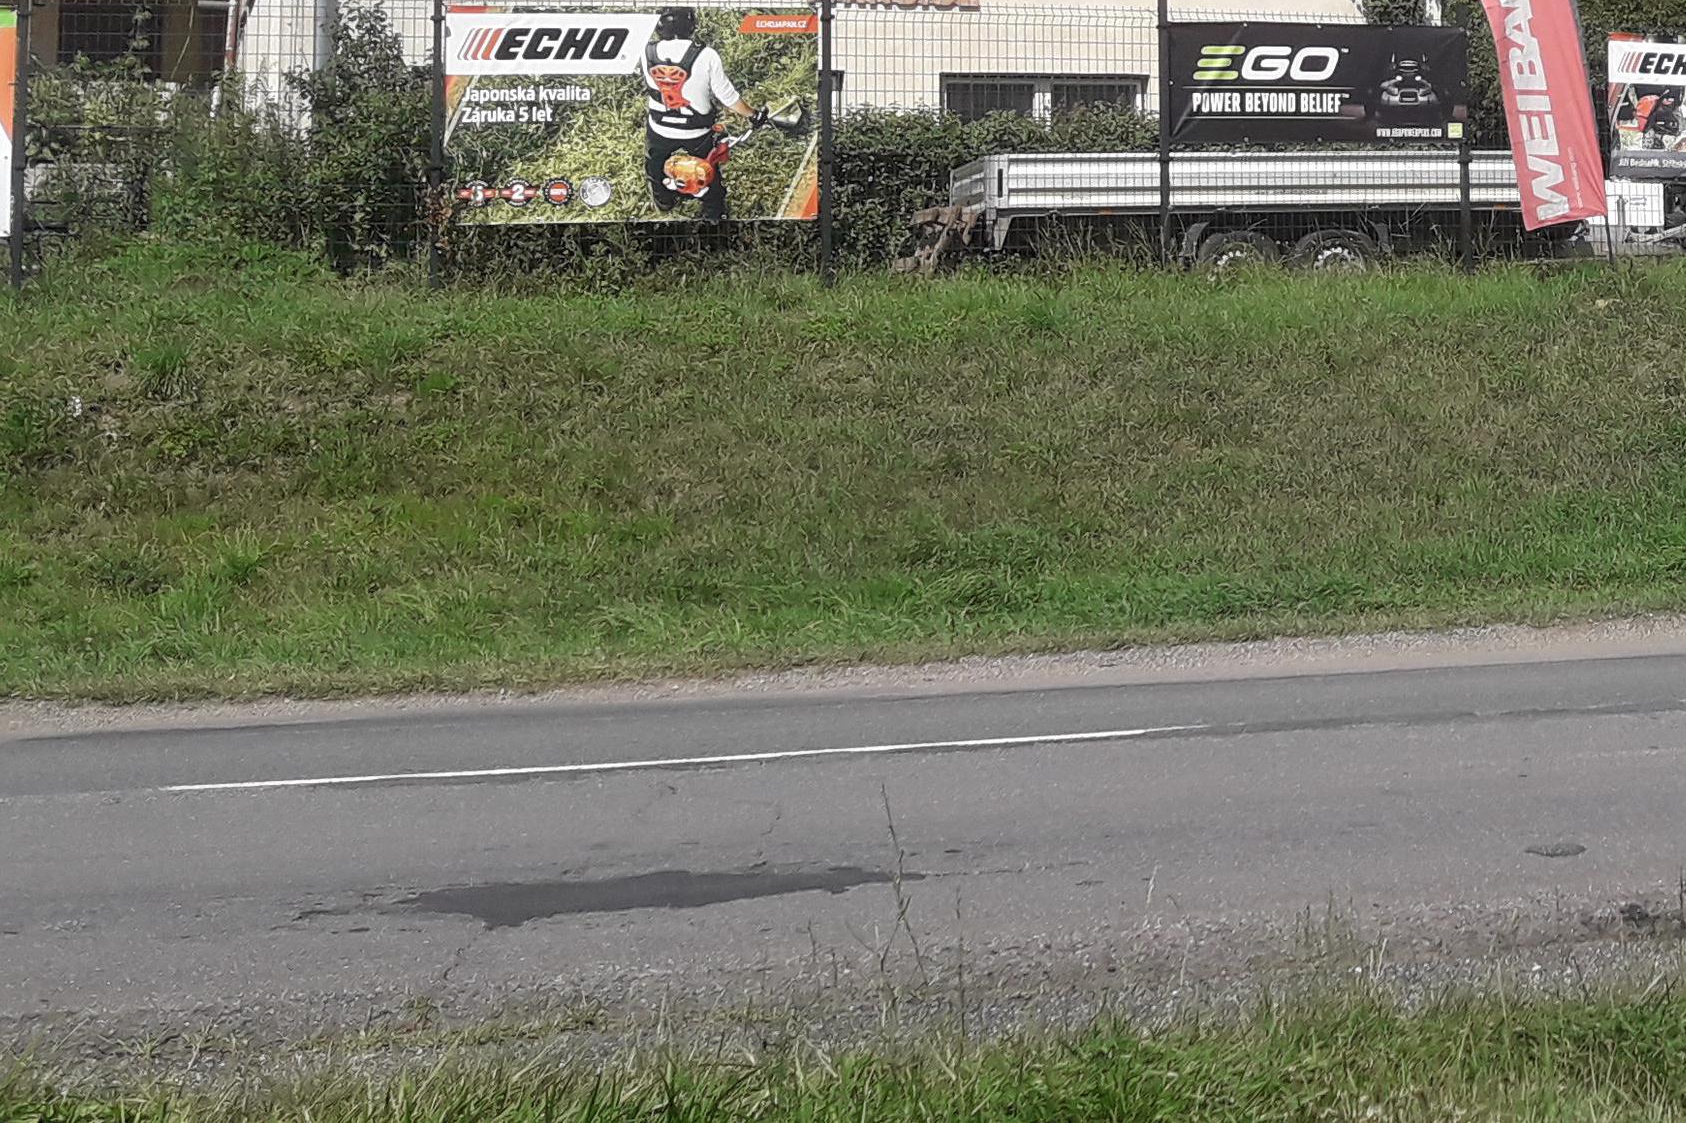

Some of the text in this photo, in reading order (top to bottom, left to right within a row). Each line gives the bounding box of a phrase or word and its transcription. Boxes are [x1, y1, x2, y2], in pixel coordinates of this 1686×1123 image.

[494, 27, 630, 61] ECHO
[1193, 45, 1340, 81] EGO
[462, 85, 591, 104] Japonská kvalita
[1192, 92, 1342, 114] POWER BEYOND BELIEF
[461, 106, 553, 123] Záruka 5 let
